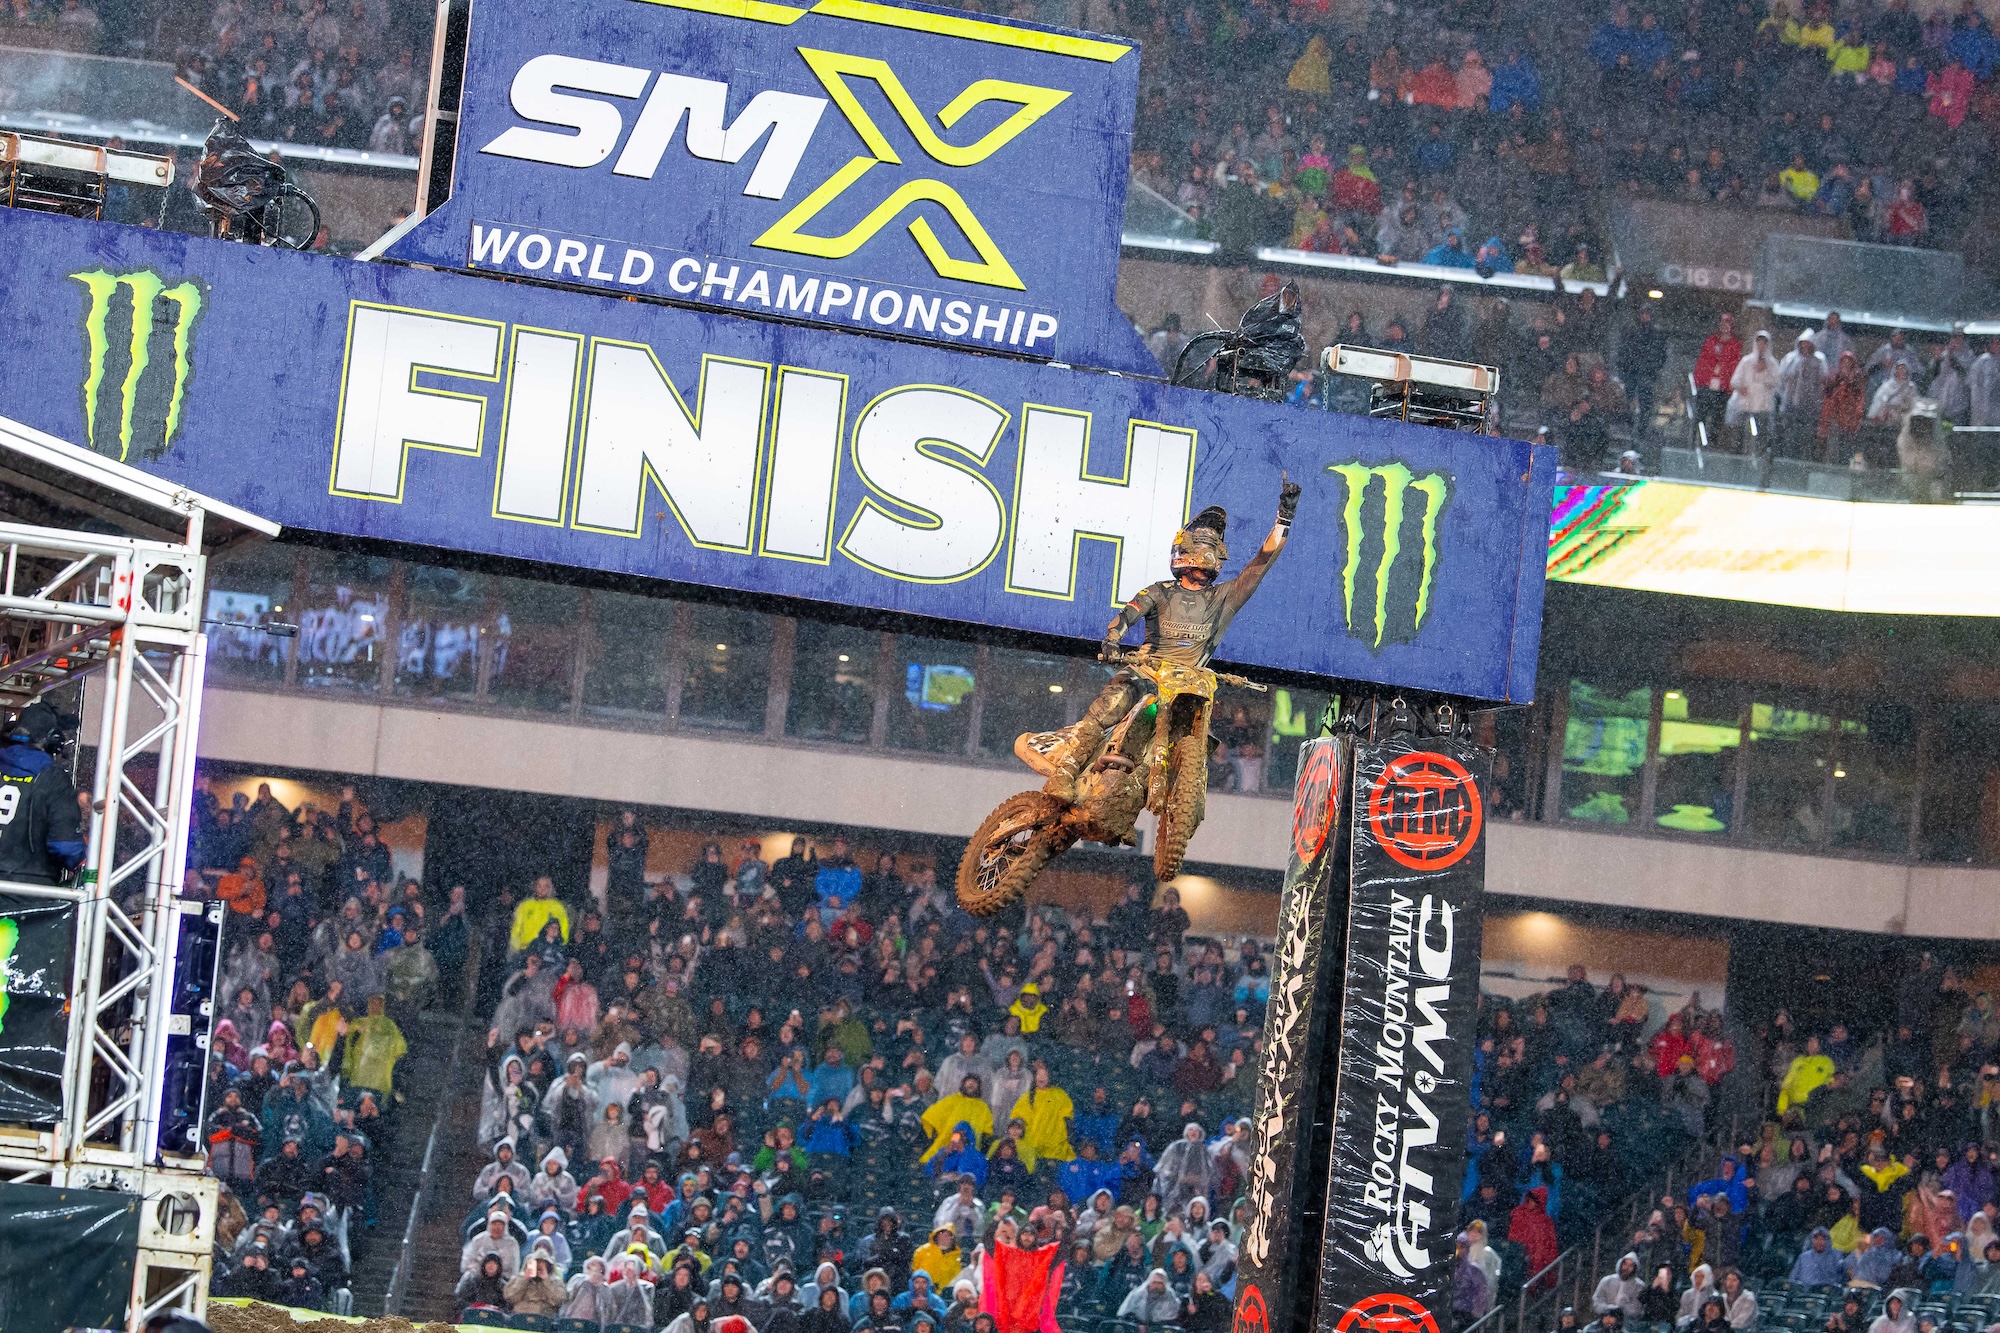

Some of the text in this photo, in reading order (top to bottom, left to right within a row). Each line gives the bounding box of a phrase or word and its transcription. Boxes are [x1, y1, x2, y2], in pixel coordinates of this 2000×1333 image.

[472, 226, 1058, 348] WORLD CHAMPIONSHIP
[480, 47, 1072, 290] SMX
[329, 300, 1198, 608] FINISH
[1165, 631, 1206, 640] SUZUKI
[1364, 890, 1414, 1216] ROCKY MOUNTAIN
